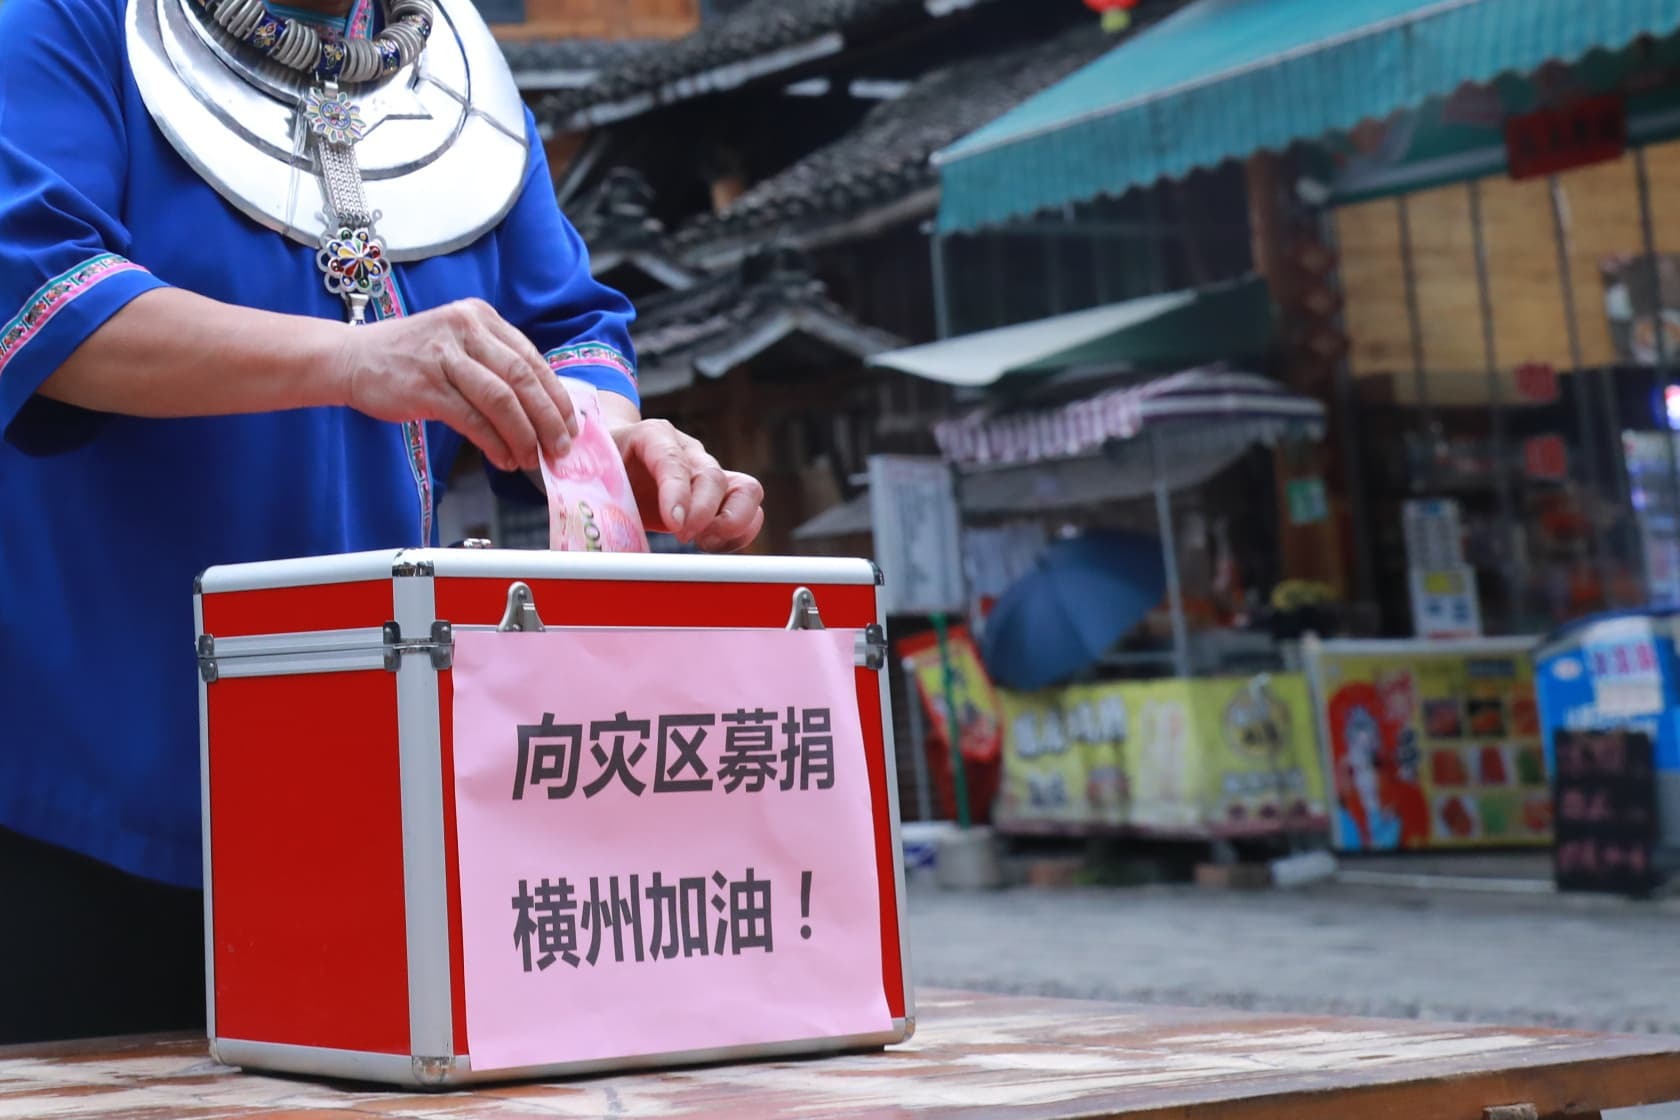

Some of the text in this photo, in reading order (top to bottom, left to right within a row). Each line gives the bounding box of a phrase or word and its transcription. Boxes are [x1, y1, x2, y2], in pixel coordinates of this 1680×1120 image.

[511, 706, 835, 801] 向灾区募捐
[511, 867, 813, 972] 横州加油！
